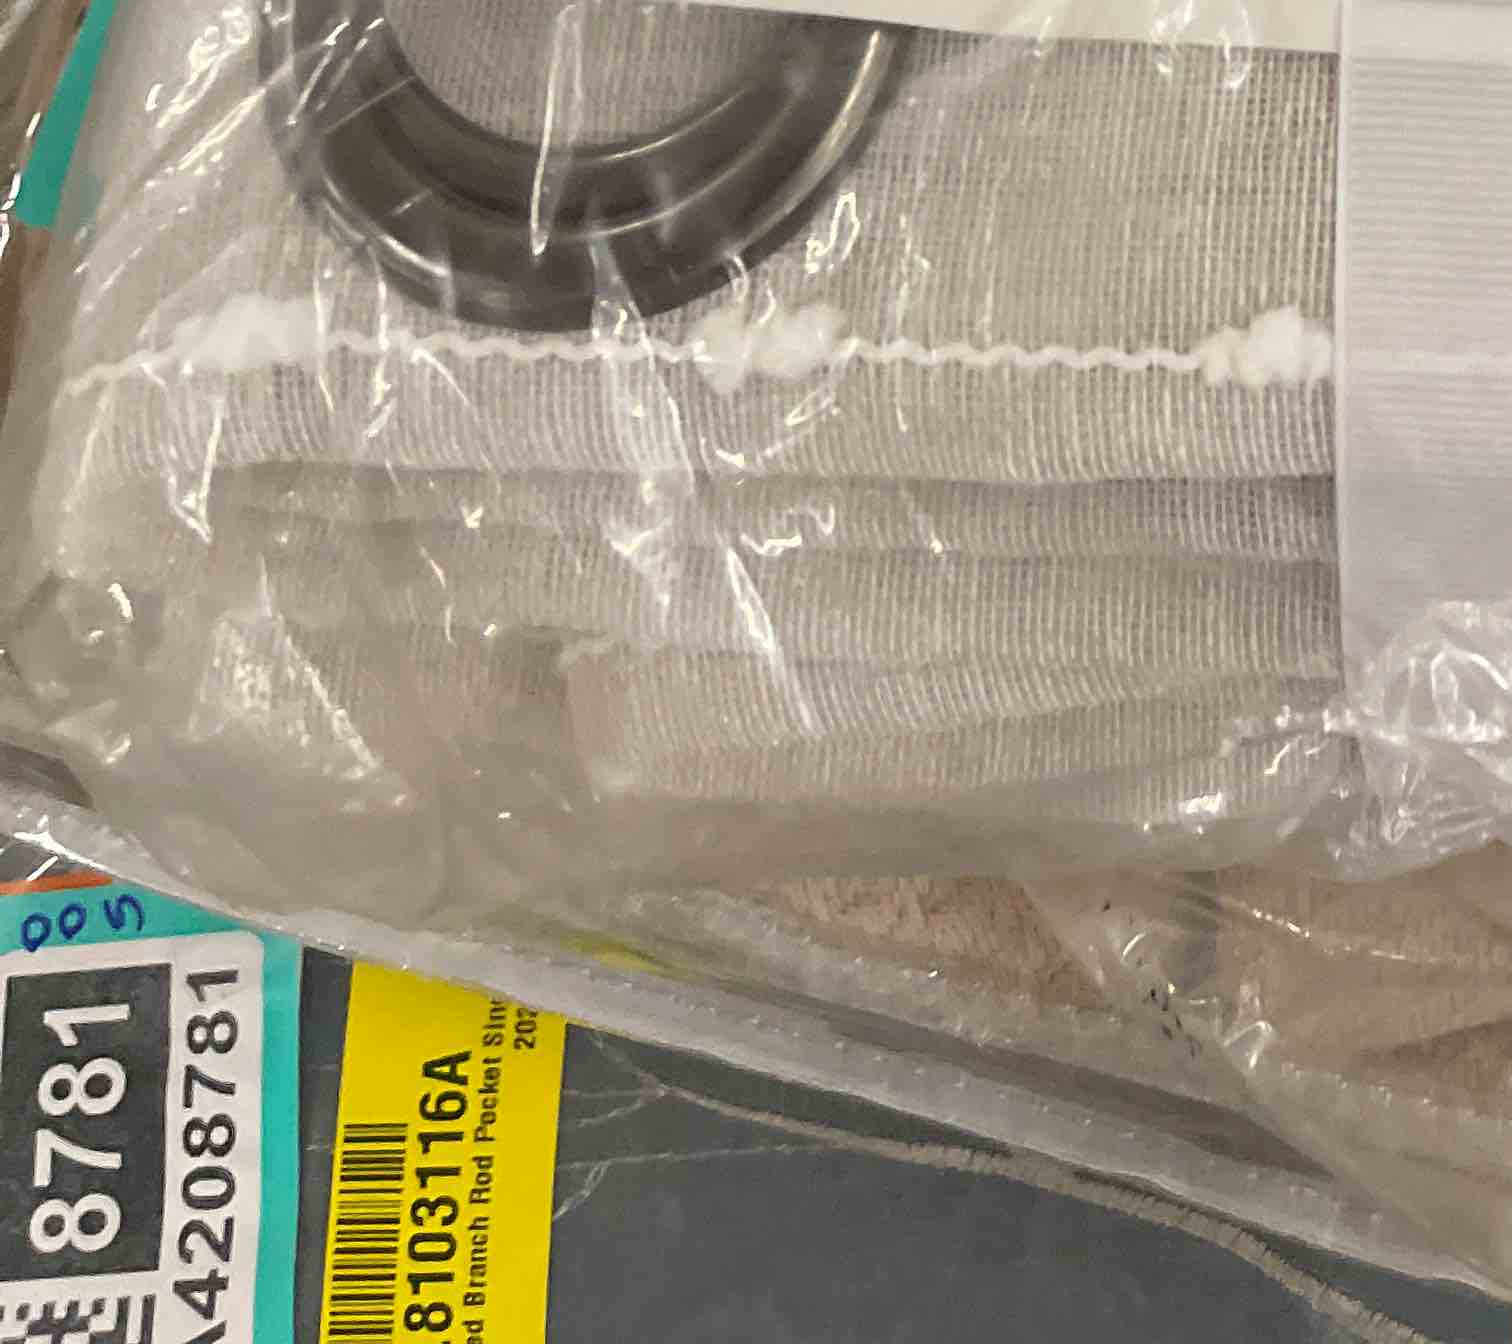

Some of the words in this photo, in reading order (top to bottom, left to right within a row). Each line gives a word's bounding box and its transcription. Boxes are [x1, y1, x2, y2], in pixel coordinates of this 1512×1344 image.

[29, 1003, 131, 1255] 8781
[473, 1057, 502, 1143] Pocket
[469, 1155, 494, 1204] Rod
[463, 1216, 489, 1306] Branch
